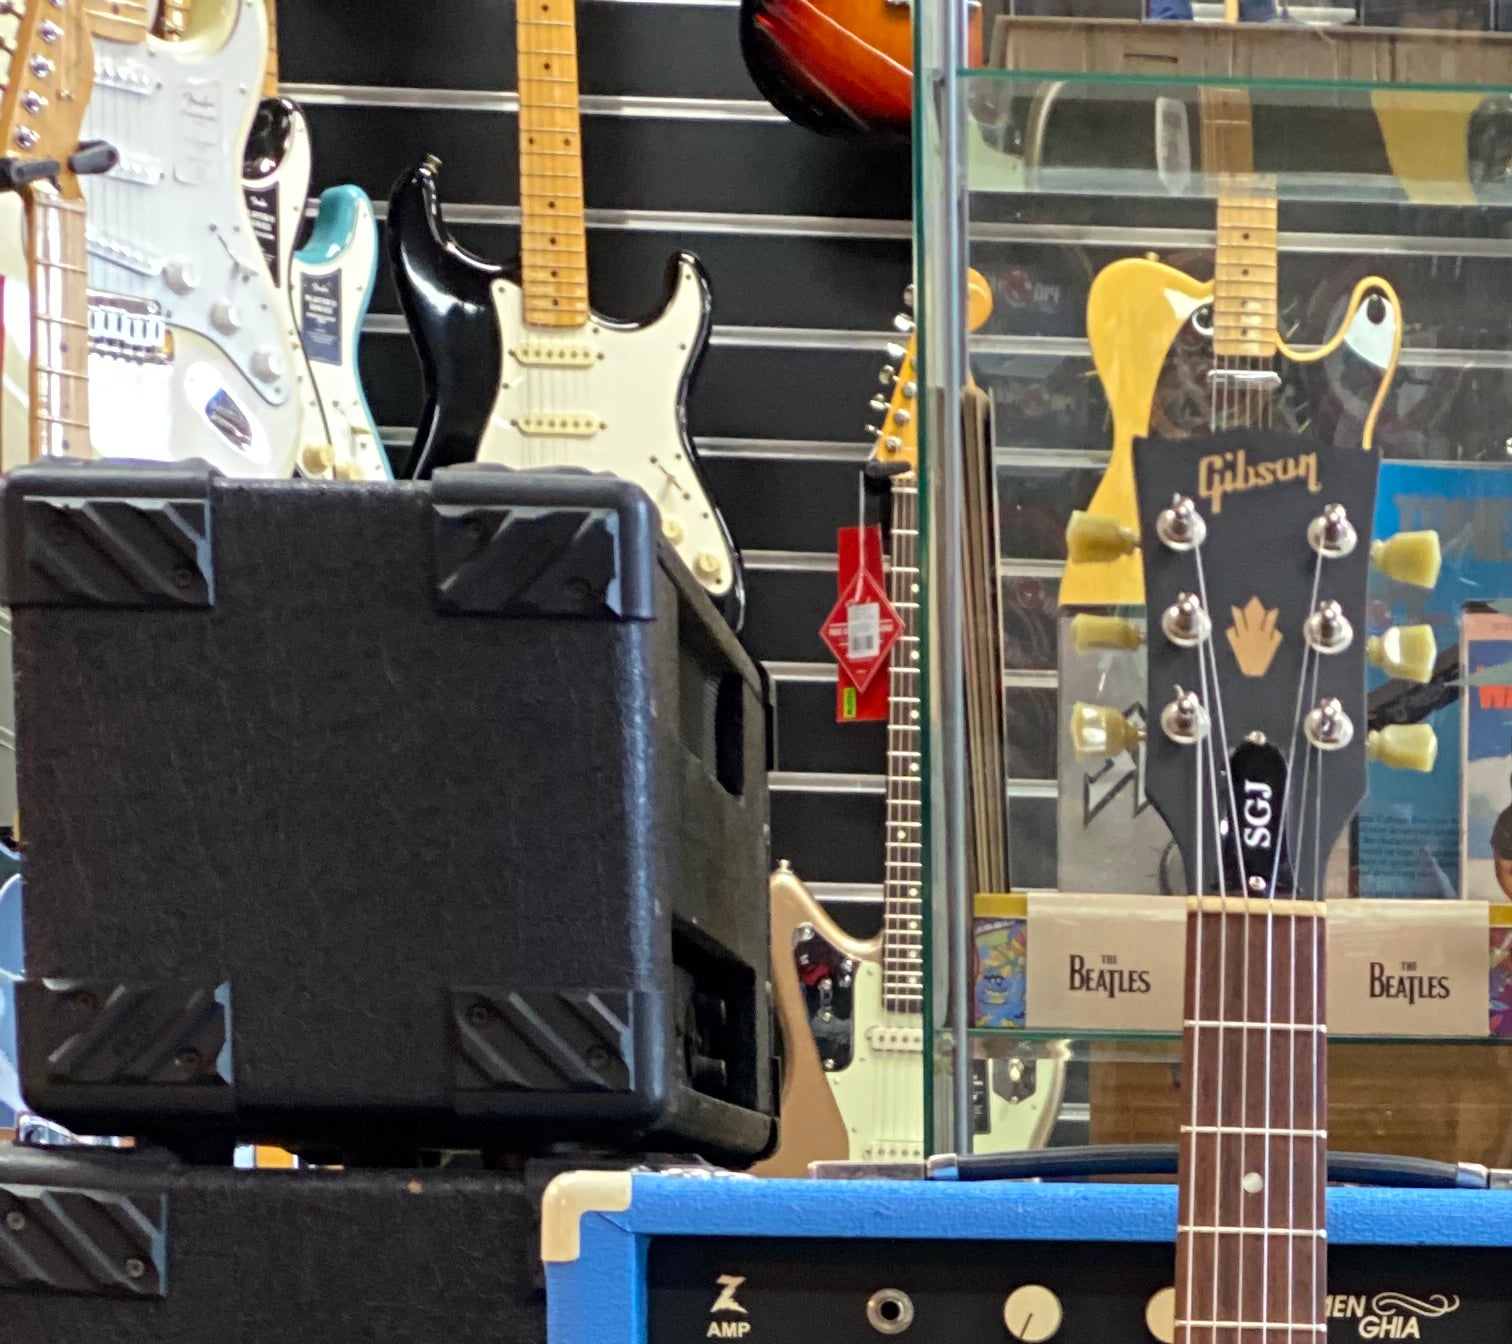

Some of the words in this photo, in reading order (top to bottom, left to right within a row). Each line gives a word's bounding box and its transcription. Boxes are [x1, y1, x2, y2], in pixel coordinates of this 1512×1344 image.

[1198, 448, 1322, 515] Gibson
[1243, 779, 1273, 848] SGJ
[1101, 954, 1118, 966] THE
[1401, 961, 1418, 971] THE
[706, 1321, 752, 1338] AMP
[1358, 1315, 1421, 1340] GHIA
